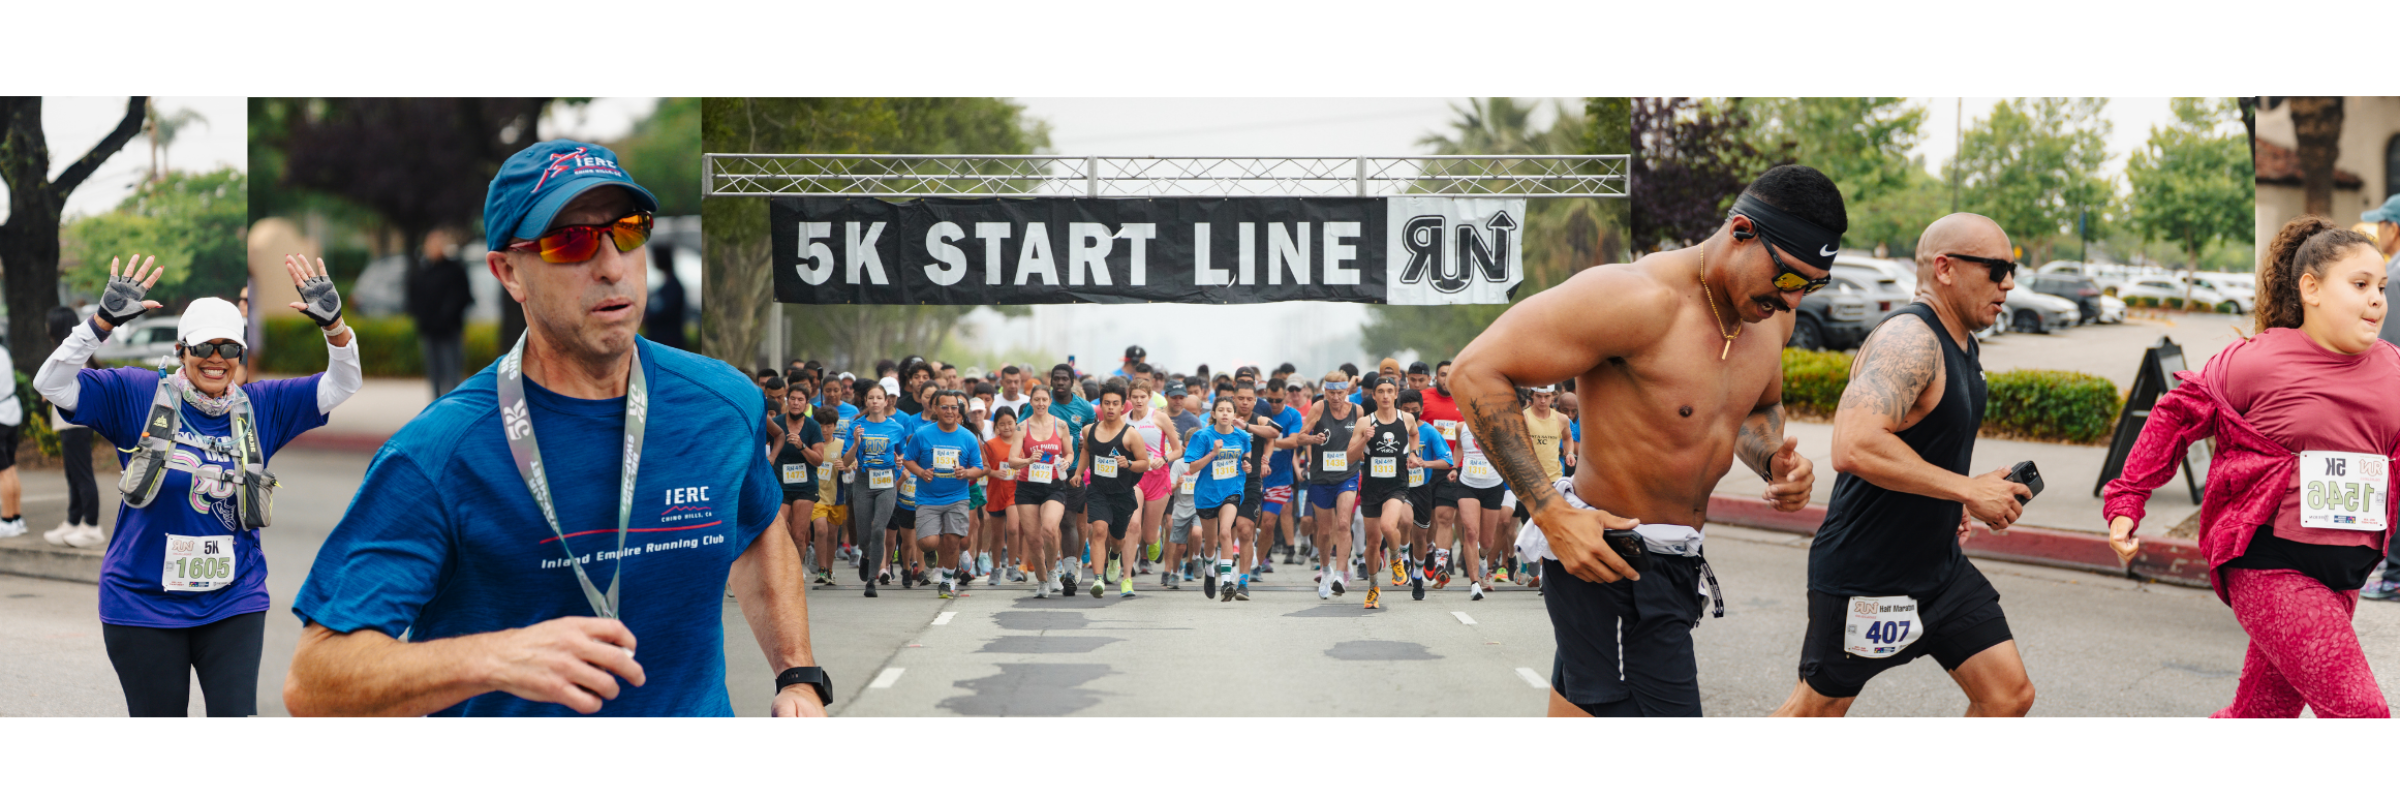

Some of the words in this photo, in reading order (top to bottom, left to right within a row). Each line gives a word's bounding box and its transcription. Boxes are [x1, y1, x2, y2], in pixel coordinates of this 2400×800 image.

[575, 157, 617, 169] IERC
[796, 221, 889, 286] 5K
[924, 221, 1156, 286] START
[1195, 221, 1361, 286] LINE
[1400, 210, 1517, 294] RUN
[503, 398, 531, 440] 5K
[785, 471, 805, 479] 1473
[1030, 470, 1050, 479] 1472
[1096, 463, 1115, 474] 1527
[1215, 466, 1235, 475] 1316
[1373, 465, 1394, 473] 1313
[1409, 475, 1422, 483] 274
[665, 486, 710, 505] IERC
[661, 514, 682, 522] CHINO
[204, 540, 219, 555] 5K
[541, 554, 590, 568] Inland
[596, 546, 642, 561] Empire
[646, 538, 699, 554] Running
[703, 534, 724, 546] Club
[176, 556, 230, 579] 1605
[1865, 620, 1911, 644] 407
